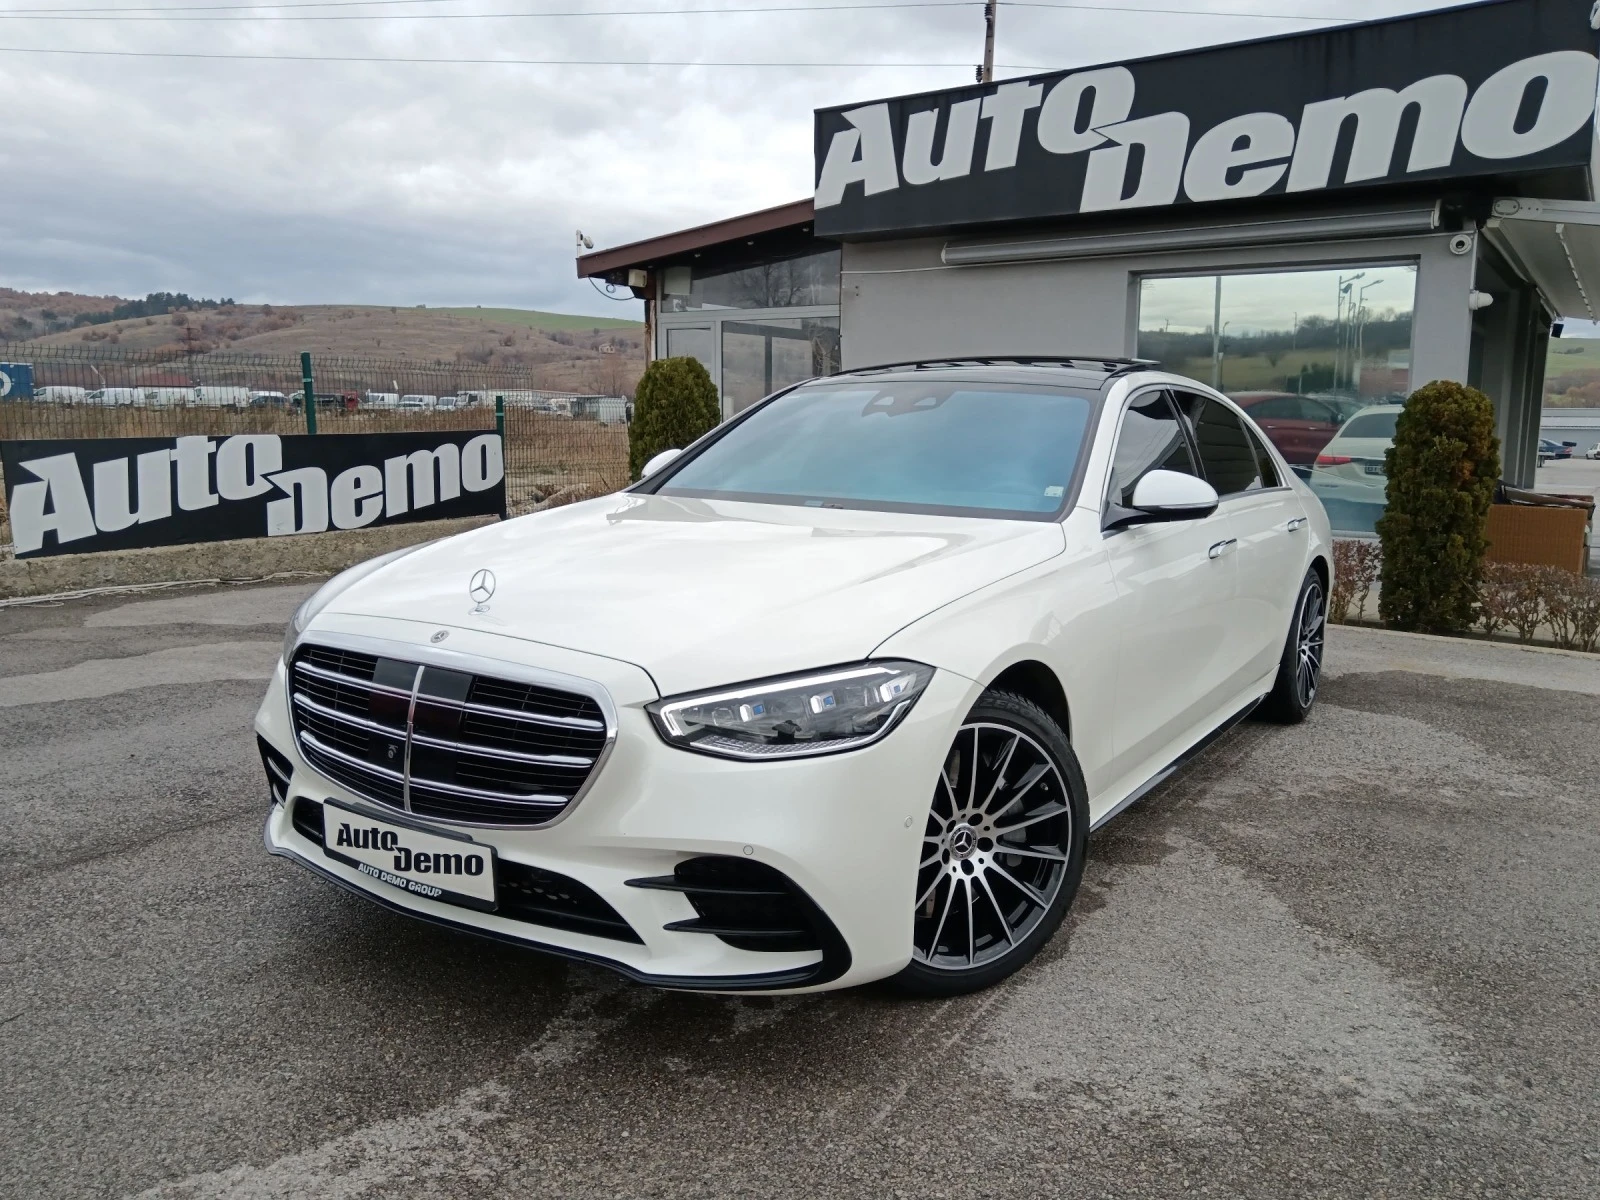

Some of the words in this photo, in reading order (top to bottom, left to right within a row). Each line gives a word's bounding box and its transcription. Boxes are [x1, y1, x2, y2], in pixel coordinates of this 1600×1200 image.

[813, 66, 1136, 210] Auto
[1079, 50, 1599, 213] Demo
[11, 434, 283, 556] Auto
[266, 433, 504, 537] Demo
[337, 823, 398, 851] Auto
[394, 847, 483, 876] Demo
[358, 863, 379, 877] AUTO
[381, 872, 406, 887] DEMO
[409, 882, 442, 897] GROUP
